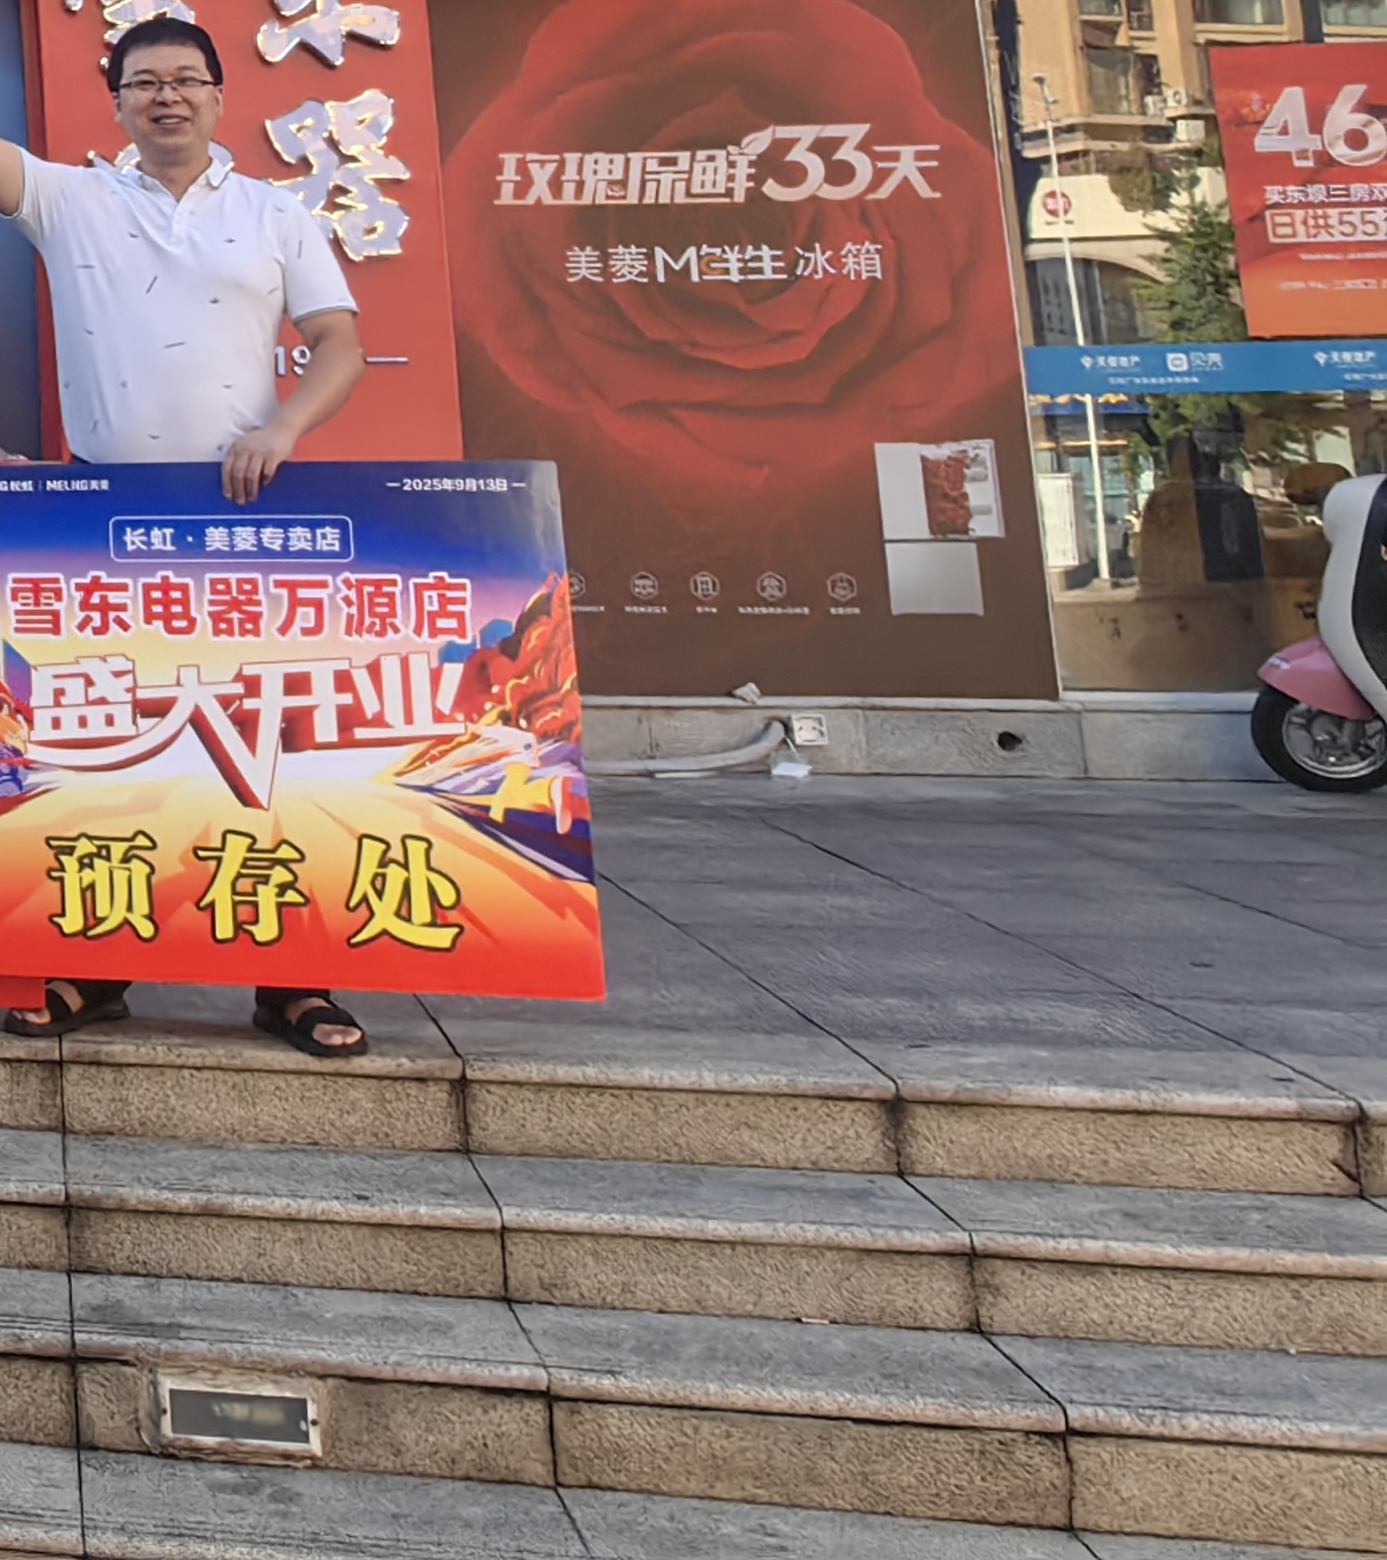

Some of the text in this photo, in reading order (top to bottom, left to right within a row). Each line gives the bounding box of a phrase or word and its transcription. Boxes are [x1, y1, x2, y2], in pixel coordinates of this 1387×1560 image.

[493, 124, 943, 206] 玫瑰保鲜33天
[402, 477, 509, 493] 2025年9月13日
[7, 573, 473, 641] 雪东电器万源店
[24, 654, 467, 811] 盛大开业
[44, 829, 462, 951] 预存处
